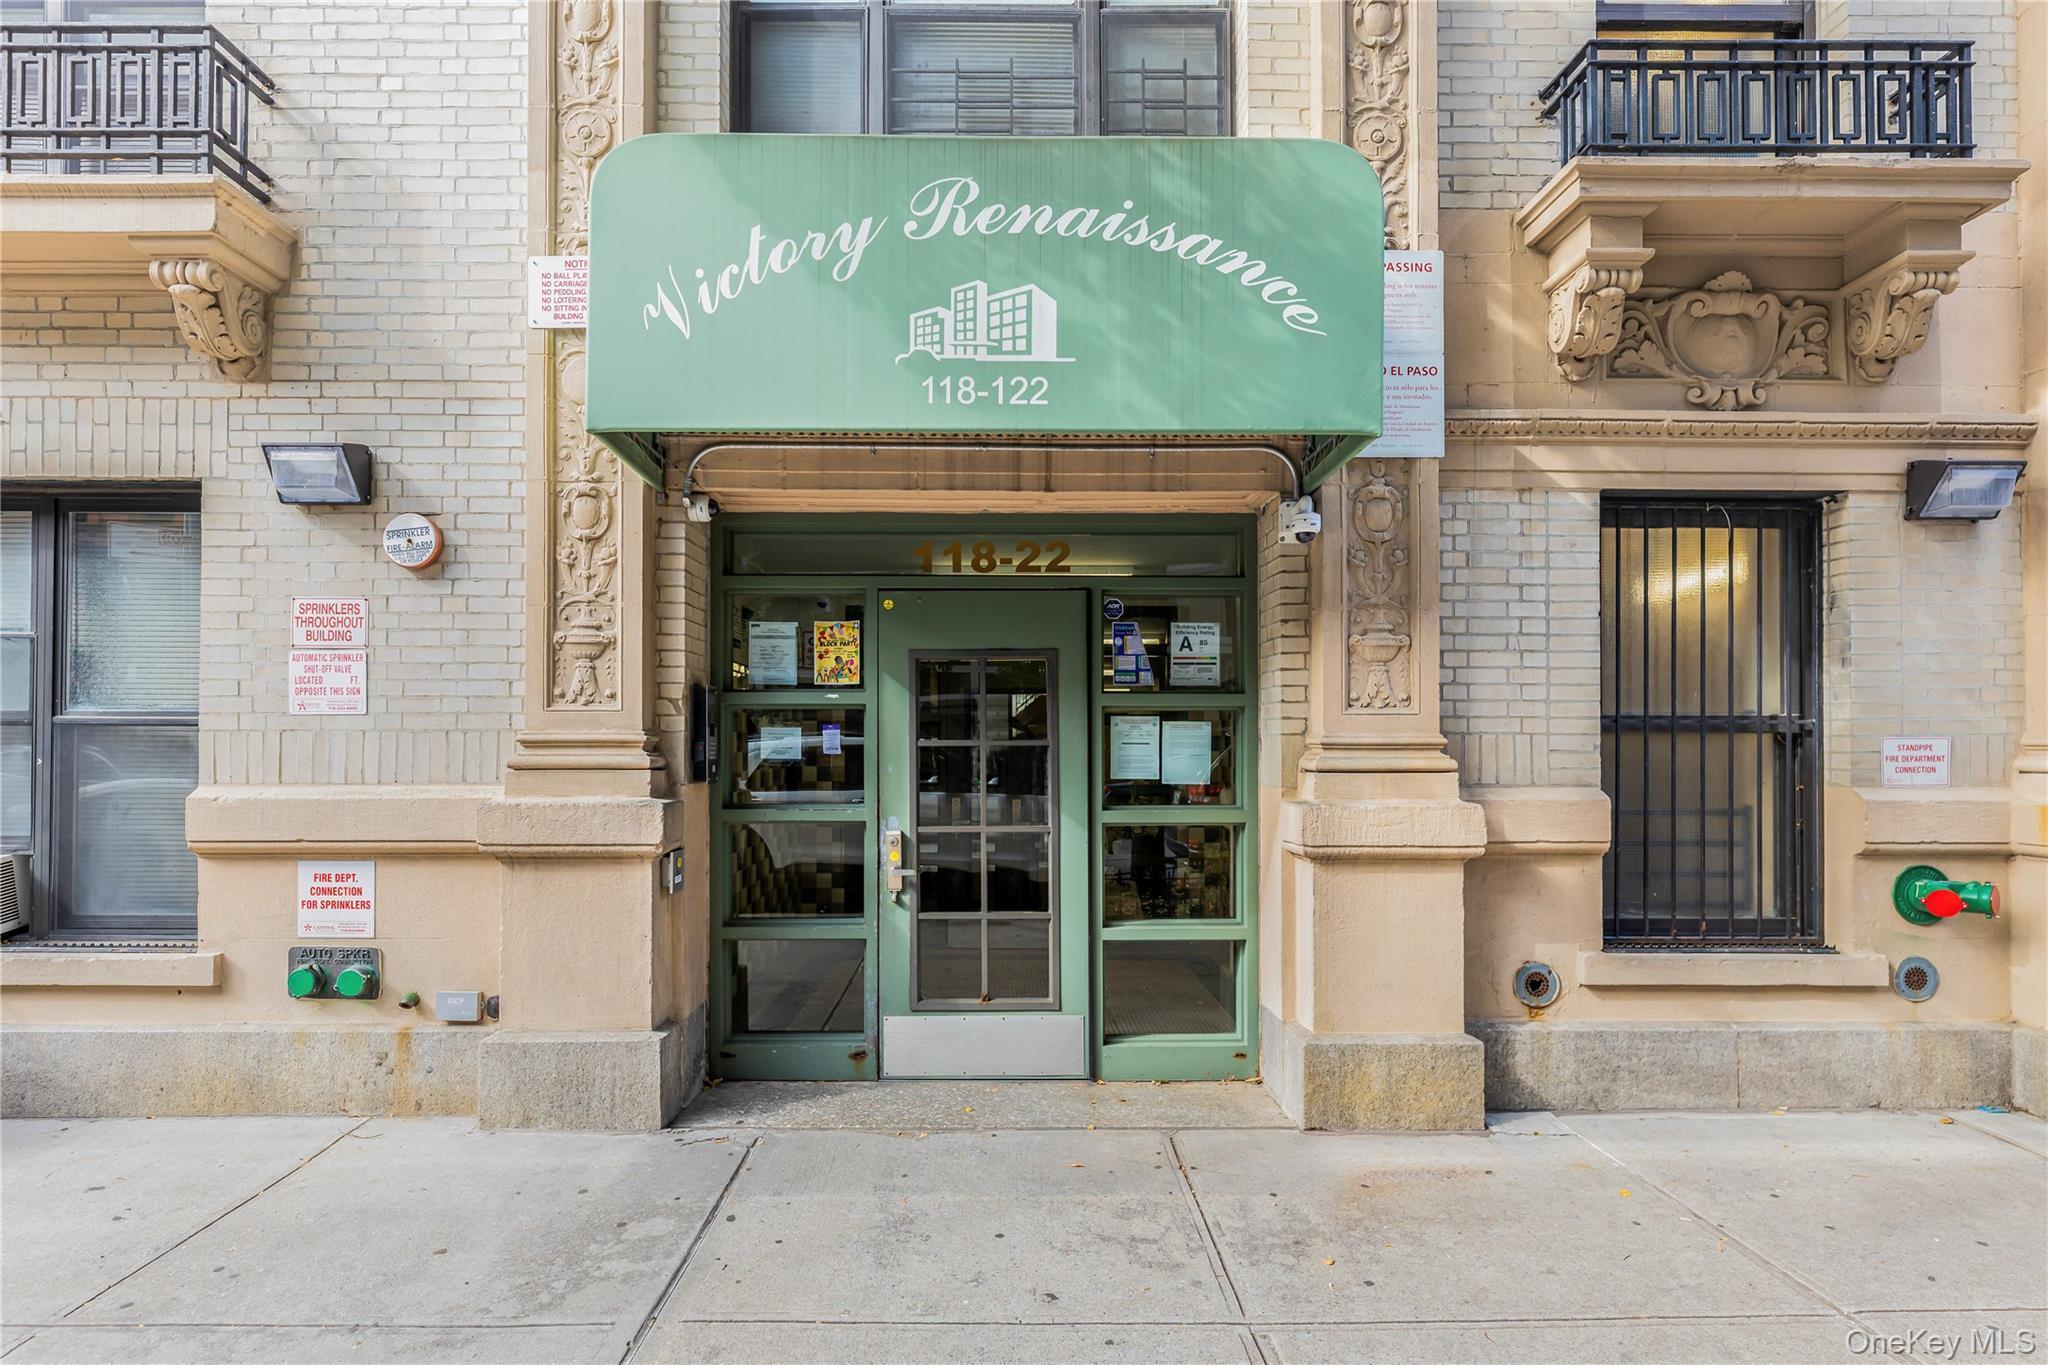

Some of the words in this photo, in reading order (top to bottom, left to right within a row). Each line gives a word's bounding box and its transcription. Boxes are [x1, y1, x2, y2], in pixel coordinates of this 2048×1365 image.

[643, 215, 889, 341] Victory
[903, 177, 1327, 337] Renaissance
[541, 280, 552, 288] NO
[1390, 366, 1404, 376] EL
[1407, 366, 1438, 376] PASO
[922, 376, 1050, 406] 118-122
[386, 527, 431, 540] SPRINKLER
[912, 540, 1072, 573] 118-22
[298, 602, 361, 615] SPRINKLERS
[295, 616, 364, 628] THROUGHOUT
[305, 629, 353, 642] BUILDING
[1178, 636, 1193, 652] A
[292, 653, 328, 662] AUTOMATIC
[329, 653, 364, 662] SPRINKLER
[303, 664, 332, 674] SHUT-OFF
[334, 664, 352, 673] VALVE
[294, 675, 323, 685] LOCATED
[350, 676, 361, 685] FT.
[294, 687, 328, 696] OPPOSITE
[329, 687, 344, 696] THIS
[346, 687, 361, 696] SIGN
[1896, 744, 1934, 752] STANDPIPE
[1894, 766, 1937, 774] CONNECTION
[313, 873, 332, 883] FIRE
[335, 873, 359, 883] DEPT.
[310, 886, 363, 896] CONNECTION
[301, 900, 318, 910] FOR
[320, 900, 371, 910] SPRINKLERS
[300, 948, 333, 959] AUTO
[338, 948, 371, 959] SPKR
